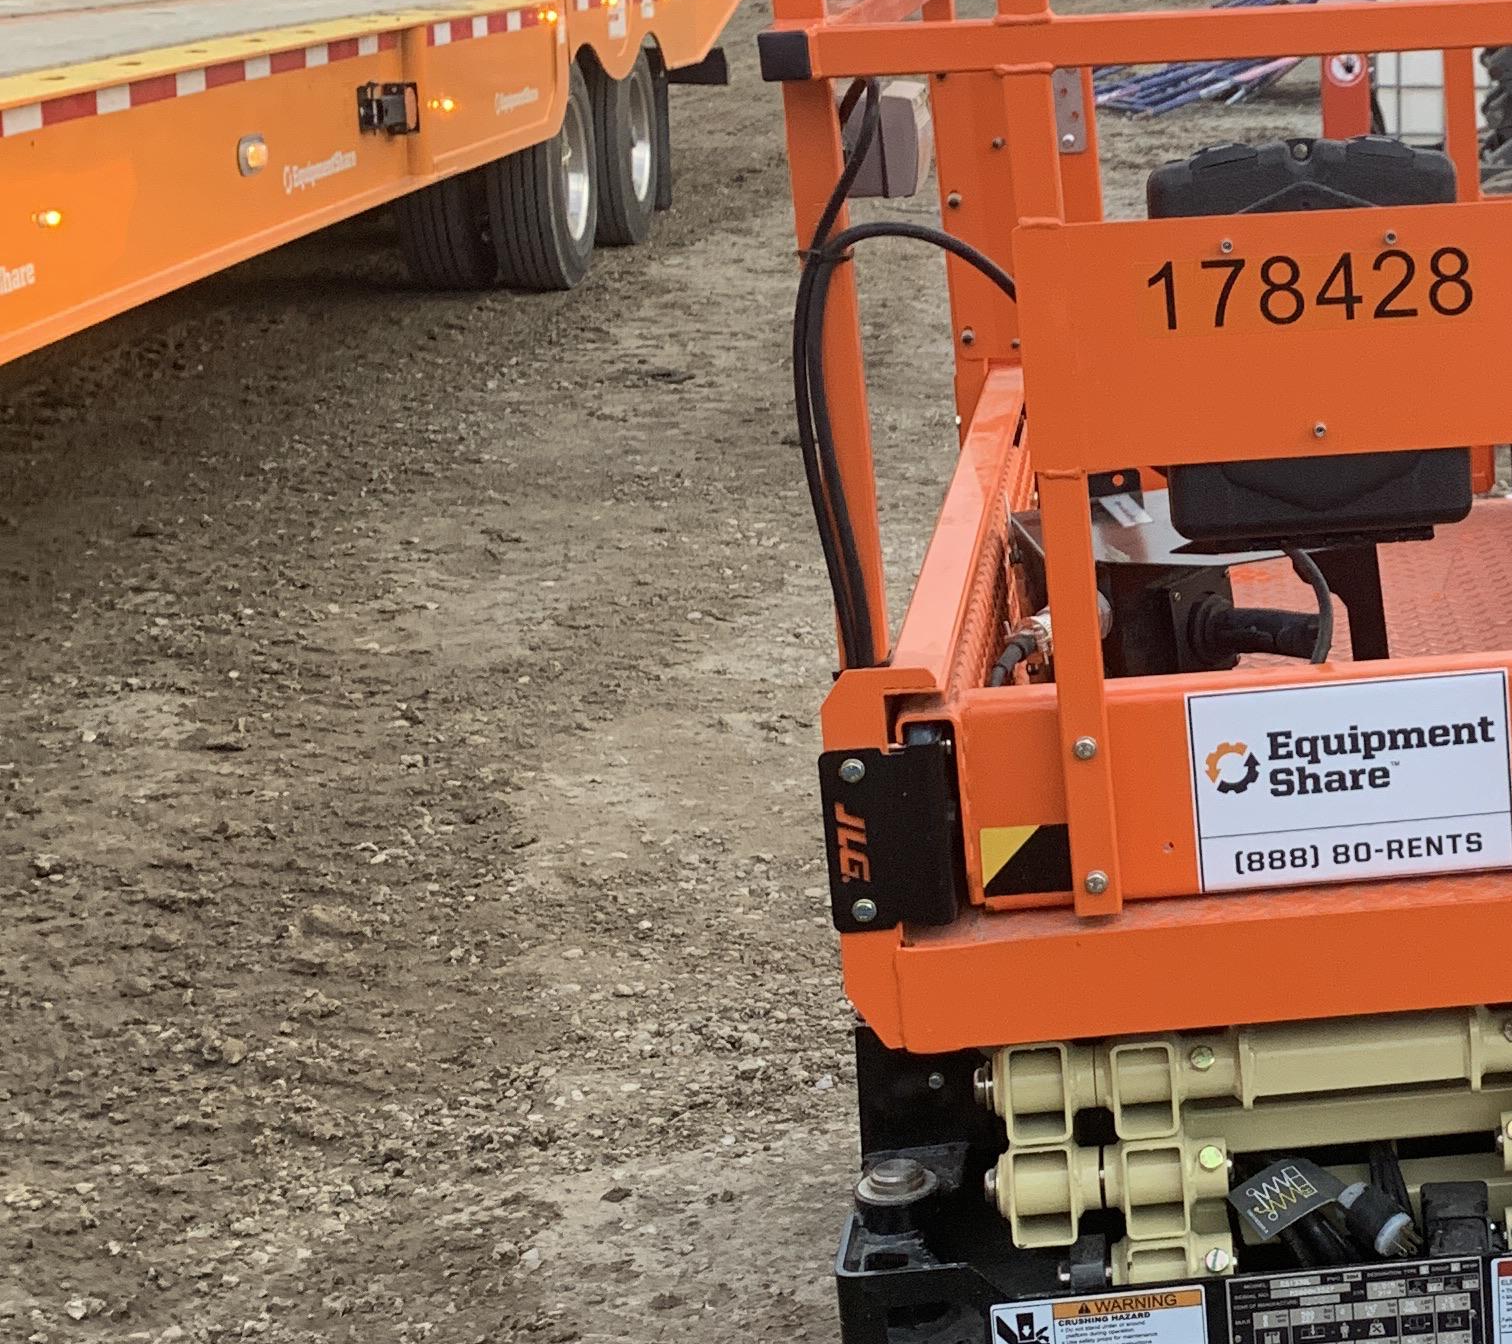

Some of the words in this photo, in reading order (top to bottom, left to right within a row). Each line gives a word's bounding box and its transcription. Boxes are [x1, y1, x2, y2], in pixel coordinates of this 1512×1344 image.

[1146, 246, 1474, 331] 178428
[1266, 715, 1496, 765] Equipment
[1268, 764, 1392, 797] Share
[834, 802, 872, 884] JLG
[1234, 843, 1320, 875] (888)
[1332, 831, 1484, 866] 80-RENTS
[1058, 1316, 1109, 1327] CRUSHING
[1111, 1311, 1151, 1321] HAZARD
[1094, 1293, 1178, 1313] WARNING
